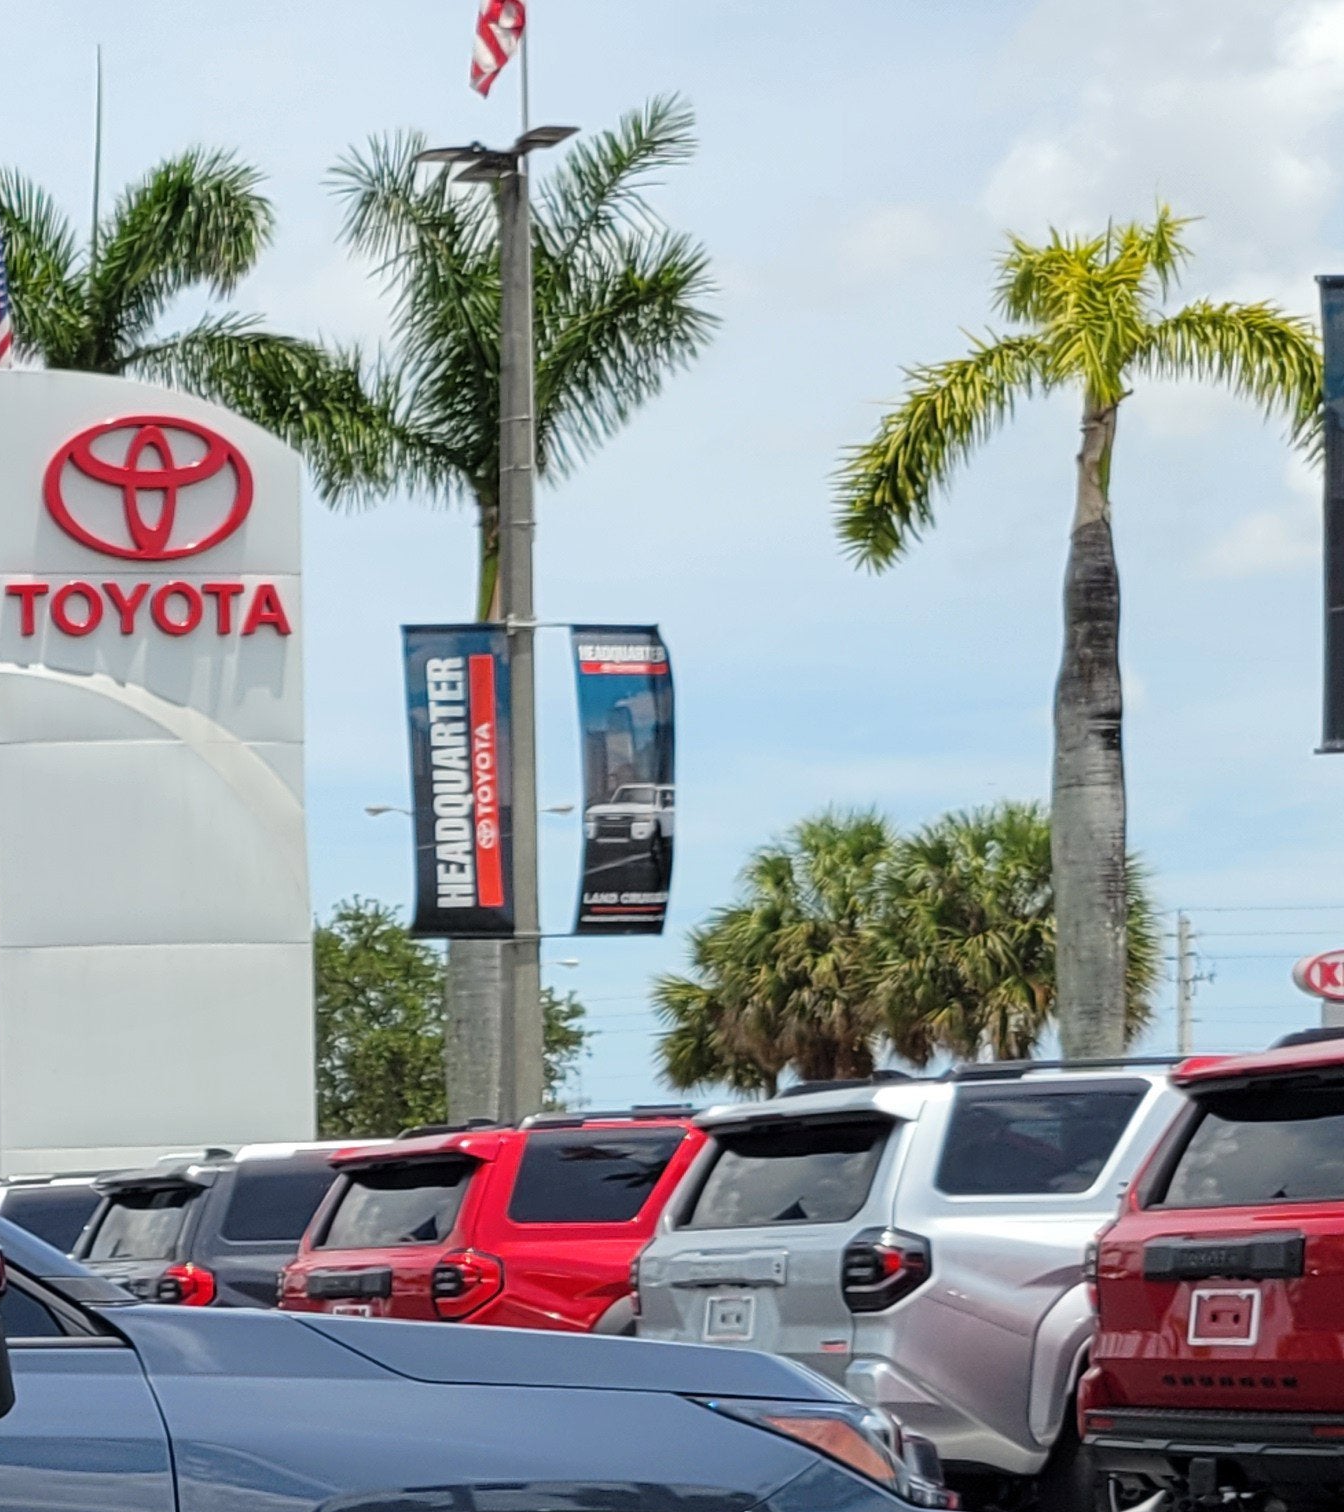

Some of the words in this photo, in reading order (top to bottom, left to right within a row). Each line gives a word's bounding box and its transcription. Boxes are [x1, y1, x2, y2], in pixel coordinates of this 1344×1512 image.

[5, 581, 292, 637] TOYOTA
[426, 656, 474, 909] HEADQUARTER
[474, 722, 496, 816] TOYOTA
